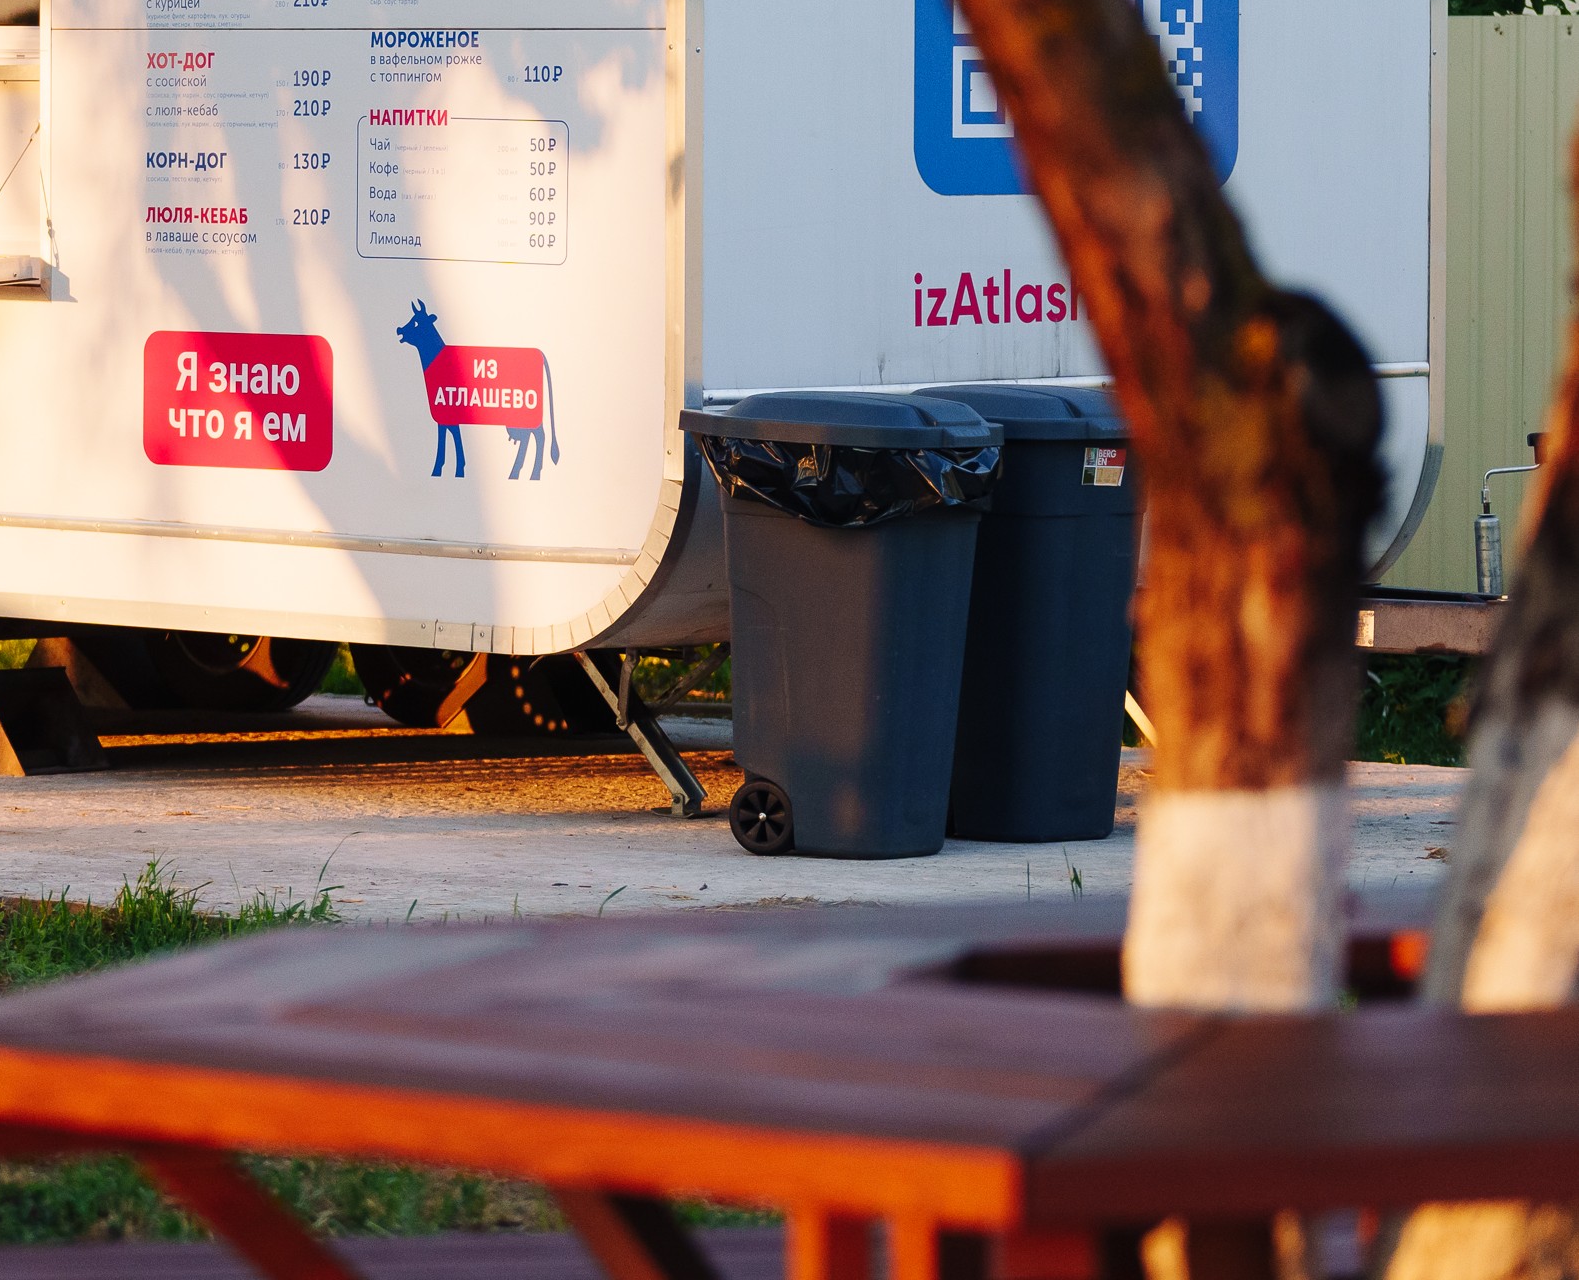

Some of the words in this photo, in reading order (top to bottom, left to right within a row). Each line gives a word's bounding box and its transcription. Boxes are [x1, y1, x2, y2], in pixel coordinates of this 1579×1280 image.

[147, 0, 152, 8] с
[370, 31, 480, 48] МОРОЖЕНОЕ
[147, 52, 215, 71] ХОТ-ДОГ
[371, 56, 376, 64] в
[379, 53, 443, 68] вафельном
[445, 55, 483, 68] рожке
[146, 77, 152, 87] с
[155, 75, 207, 87] сосиской
[370, 72, 376, 82] с
[379, 72, 442, 82] топпингом
[146, 107, 152, 117] с
[155, 104, 218, 117] люля-кебаб
[370, 108, 448, 126] НАПИТКИ
[369, 138, 390, 151] Чай
[147, 152, 228, 171] КОРН-ДОГ
[369, 161, 399, 177] Кофе
[369, 186, 397, 201] Вода
[146, 207, 249, 224] ЛЮЛЯ-КЕБАБ
[369, 210, 395, 223] Кола
[146, 232, 152, 241] в
[155, 232, 198, 242] лаваше
[202, 233, 209, 242] с
[212, 233, 257, 246] соусом
[370, 232, 422, 247] Лимонад
[175, 351, 198, 392] Я
[208, 361, 300, 397] знаю
[473, 358, 498, 380] ИЗ
[434, 386, 538, 410] АТЛАШЕВО
[168, 407, 225, 439] что
[233, 411, 253, 440] я
[262, 411, 307, 443] ем
[1098, 449, 1117, 458] BERG
[1097, 458, 1108, 466] EN
